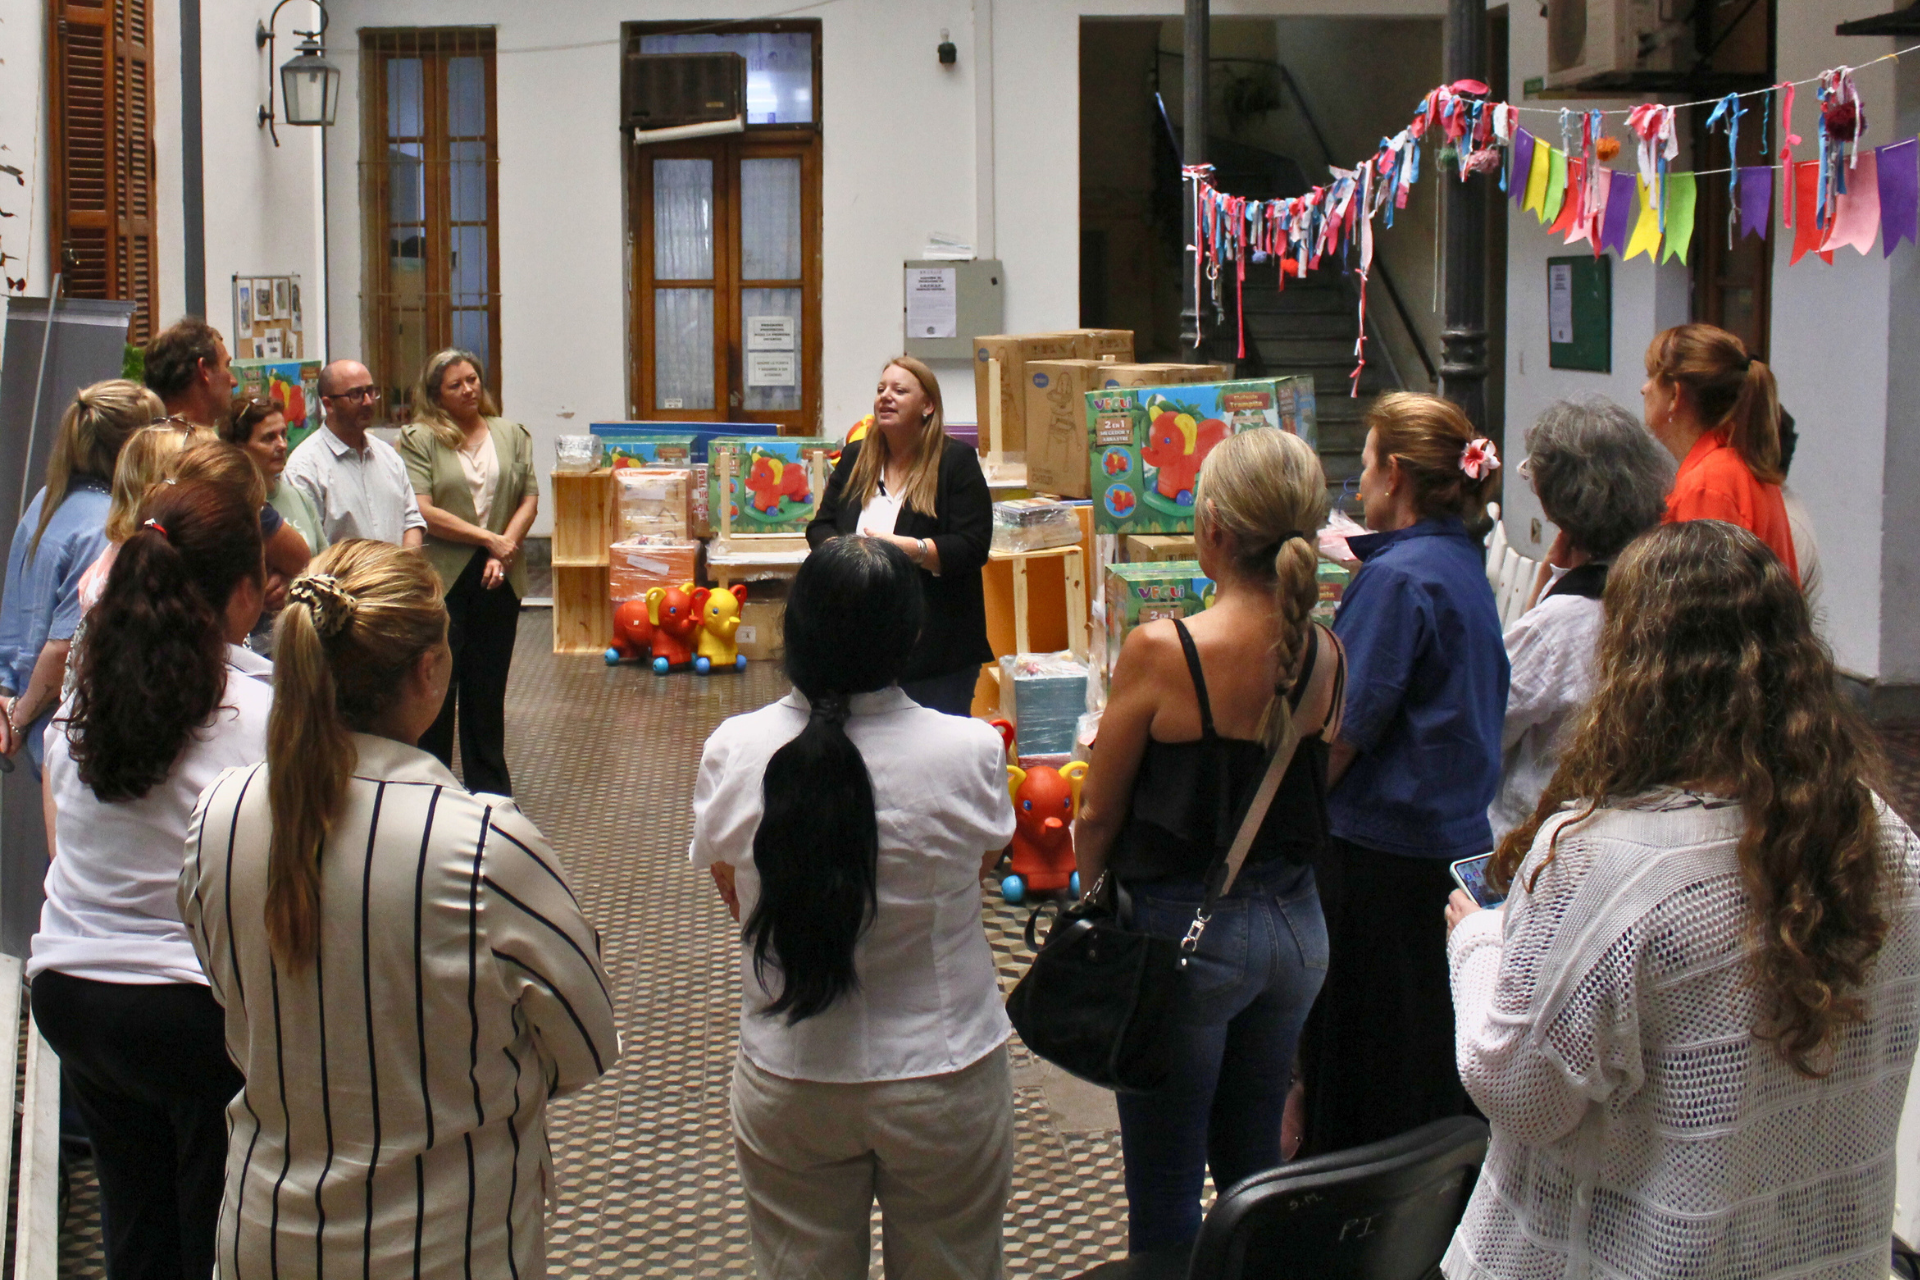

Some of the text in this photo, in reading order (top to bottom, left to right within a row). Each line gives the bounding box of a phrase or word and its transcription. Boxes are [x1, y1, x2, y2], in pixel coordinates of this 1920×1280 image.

[1104, 420, 1111, 429] 2
[1120, 420, 1125, 428] 1
[1150, 610, 1158, 620] 2
[1170, 610, 1175, 619] 1
